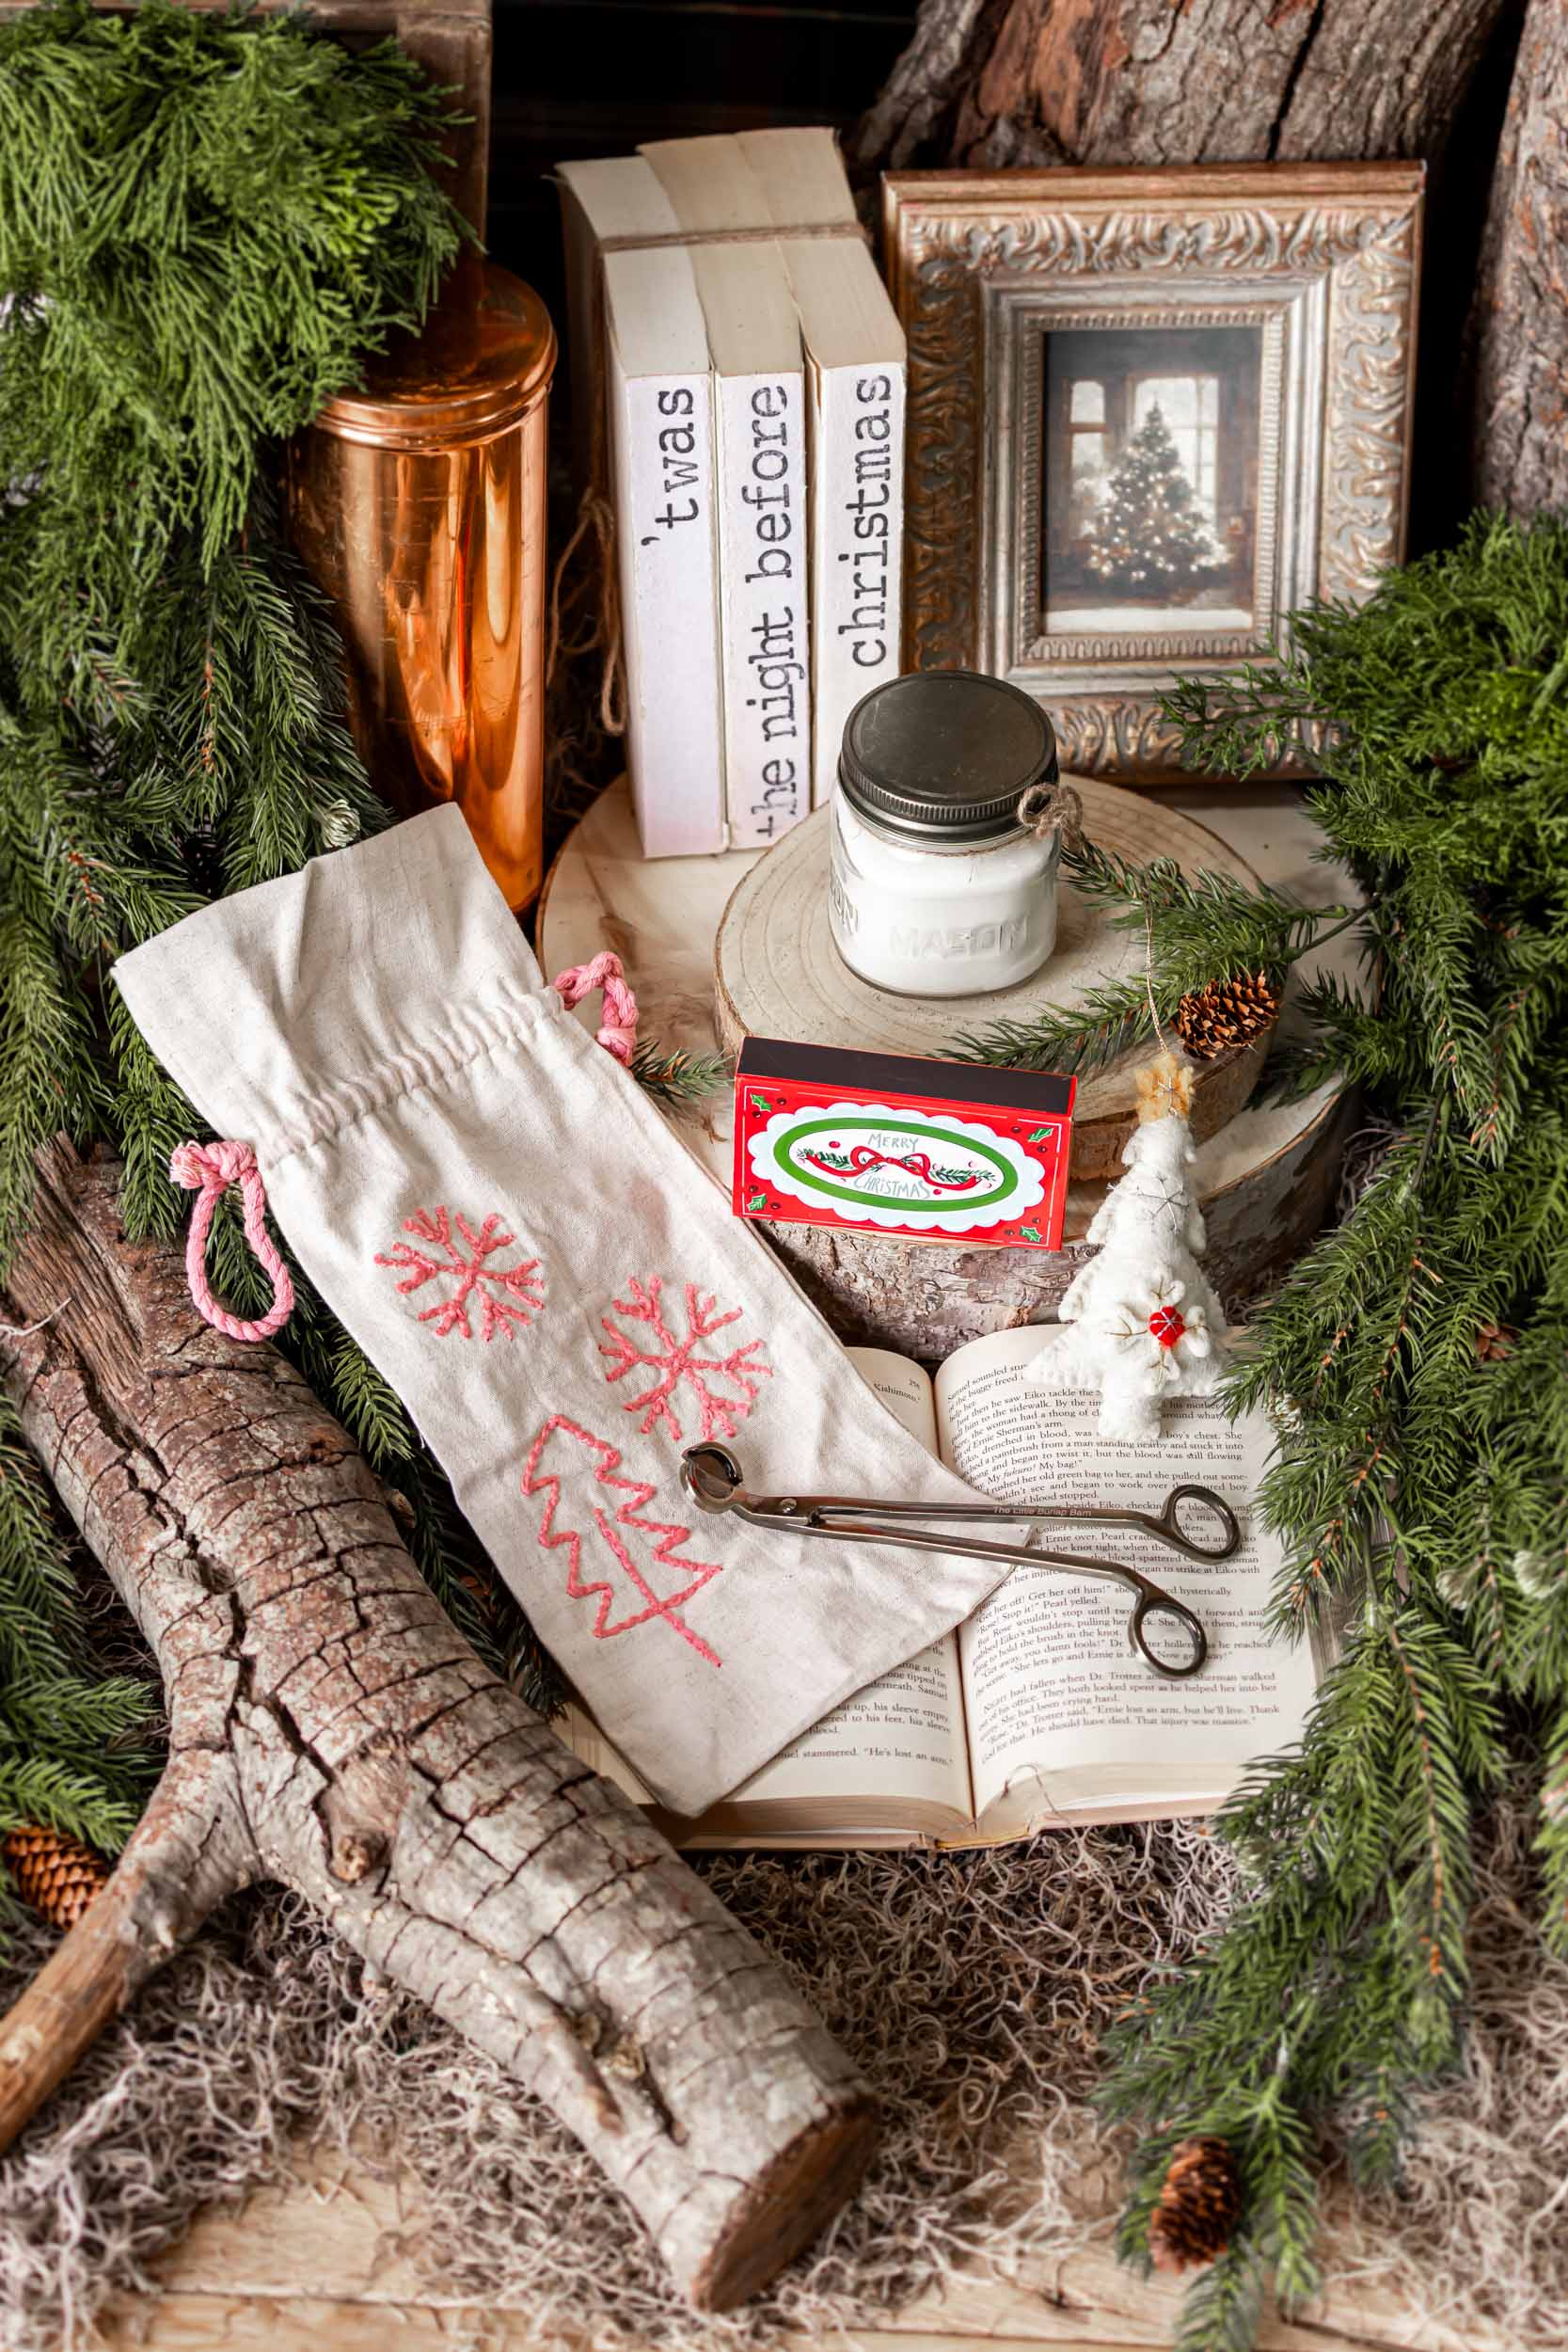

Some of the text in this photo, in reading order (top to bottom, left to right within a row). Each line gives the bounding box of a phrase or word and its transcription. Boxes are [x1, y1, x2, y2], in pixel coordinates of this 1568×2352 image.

[641, 387, 699, 547] 'twas
[838, 374, 892, 668] christmas
[742, 385, 806, 838] the night before
[867, 1133, 919, 1152] MERRY
[1005, 1395, 1022, 1404] saw
[1024, 1390, 1046, 1400] Eiko
[1049, 1389, 1076, 1398] tackle
[1079, 1389, 1094, 1397] the
[992, 1398, 1086, 1419] the By the
[986, 1408, 1089, 1432] woman had thong of
[996, 1422, 1042, 1438] Sherman's
[982, 1434, 1023, 1454] drenched
[1040, 1429, 1070, 1439] blood,
[1194, 1430, 1221, 1439] chest.
[1225, 1430, 1243, 1439] She
[991, 1442, 1039, 1461] paintbrush
[1040, 1440, 1064, 1450] from
[1137, 1439, 1167, 1450] nearby
[1170, 1440, 1187, 1449] and
[1189, 1440, 1214, 1450] stuck
[1225, 1440, 1243, 1450] into
[991, 1463, 1008, 1473] and
[1010, 1454, 1038, 1466] began
[1055, 1450, 1079, 1458] twist
[1096, 1449, 1112, 1458] but
[1116, 1449, 1131, 1458] the
[1134, 1450, 1162, 1459] blood
[1186, 1451, 1203, 1460] still
[1207, 1451, 1243, 1461] flowing
[988, 1472, 1002, 1484] My
[1039, 1460, 1054, 1470] My
[1022, 1473, 1037, 1484] her
[1039, 1470, 1055, 1479] old
[1057, 1472, 1083, 1481] green
[1085, 1469, 1101, 1480] bag
[1135, 1470, 1152, 1479] and
[1154, 1470, 1170, 1479] she
[1172, 1470, 1201, 1481] pulled
[1030, 1485, 1045, 1493] see
[1050, 1480, 1068, 1490] and
[1071, 1480, 1101, 1490] began
[1119, 1480, 1144, 1489] work
[1029, 1490, 1100, 1504] blood stopped.
[1099, 1501, 1123, 1511] Eiko,
[1185, 1513, 1193, 1521] A
[1045, 1534, 1071, 1544] Ernie
[1074, 1534, 1098, 1543] over,
[1101, 1532, 1126, 1542] Pearl
[1070, 1542, 1167, 1552] knot tight, when the
[1108, 1552, 1181, 1564] blood-spattered
[1164, 1565, 1174, 1573] to
[1176, 1565, 1203, 1574] strike
[1214, 1565, 1238, 1575] Eiko
[1240, 1565, 1261, 1575] with
[1028, 1586, 1081, 1601] Get her off
[1043, 1597, 1069, 1609] Pearl
[1016, 1607, 1244, 1627] wouldn't stop until forward
[1077, 1617, 1111, 1629] pulling
[1113, 1617, 1128, 1627] her
[1158, 1617, 1175, 1627] She
[1212, 1617, 1238, 1629] them,
[1021, 1638, 1035, 1648] the
[1037, 1632, 1065, 1643] brush
[1080, 1629, 1095, 1638] the
[1044, 1641, 1231, 1654] damn he
[1067, 1650, 1085, 1661] and
[908, 1674, 936, 1686] tipped
[1241, 1672, 1275, 1681] walked
[1068, 1683, 1091, 1693] both
[1185, 1682, 1217, 1694] helped
[875, 1702, 888, 1711] his
[892, 1703, 920, 1714] sleeve
[866, 1713, 880, 1723] his
[910, 1715, 924, 1726] his
[895, 1748, 912, 1758] lost
